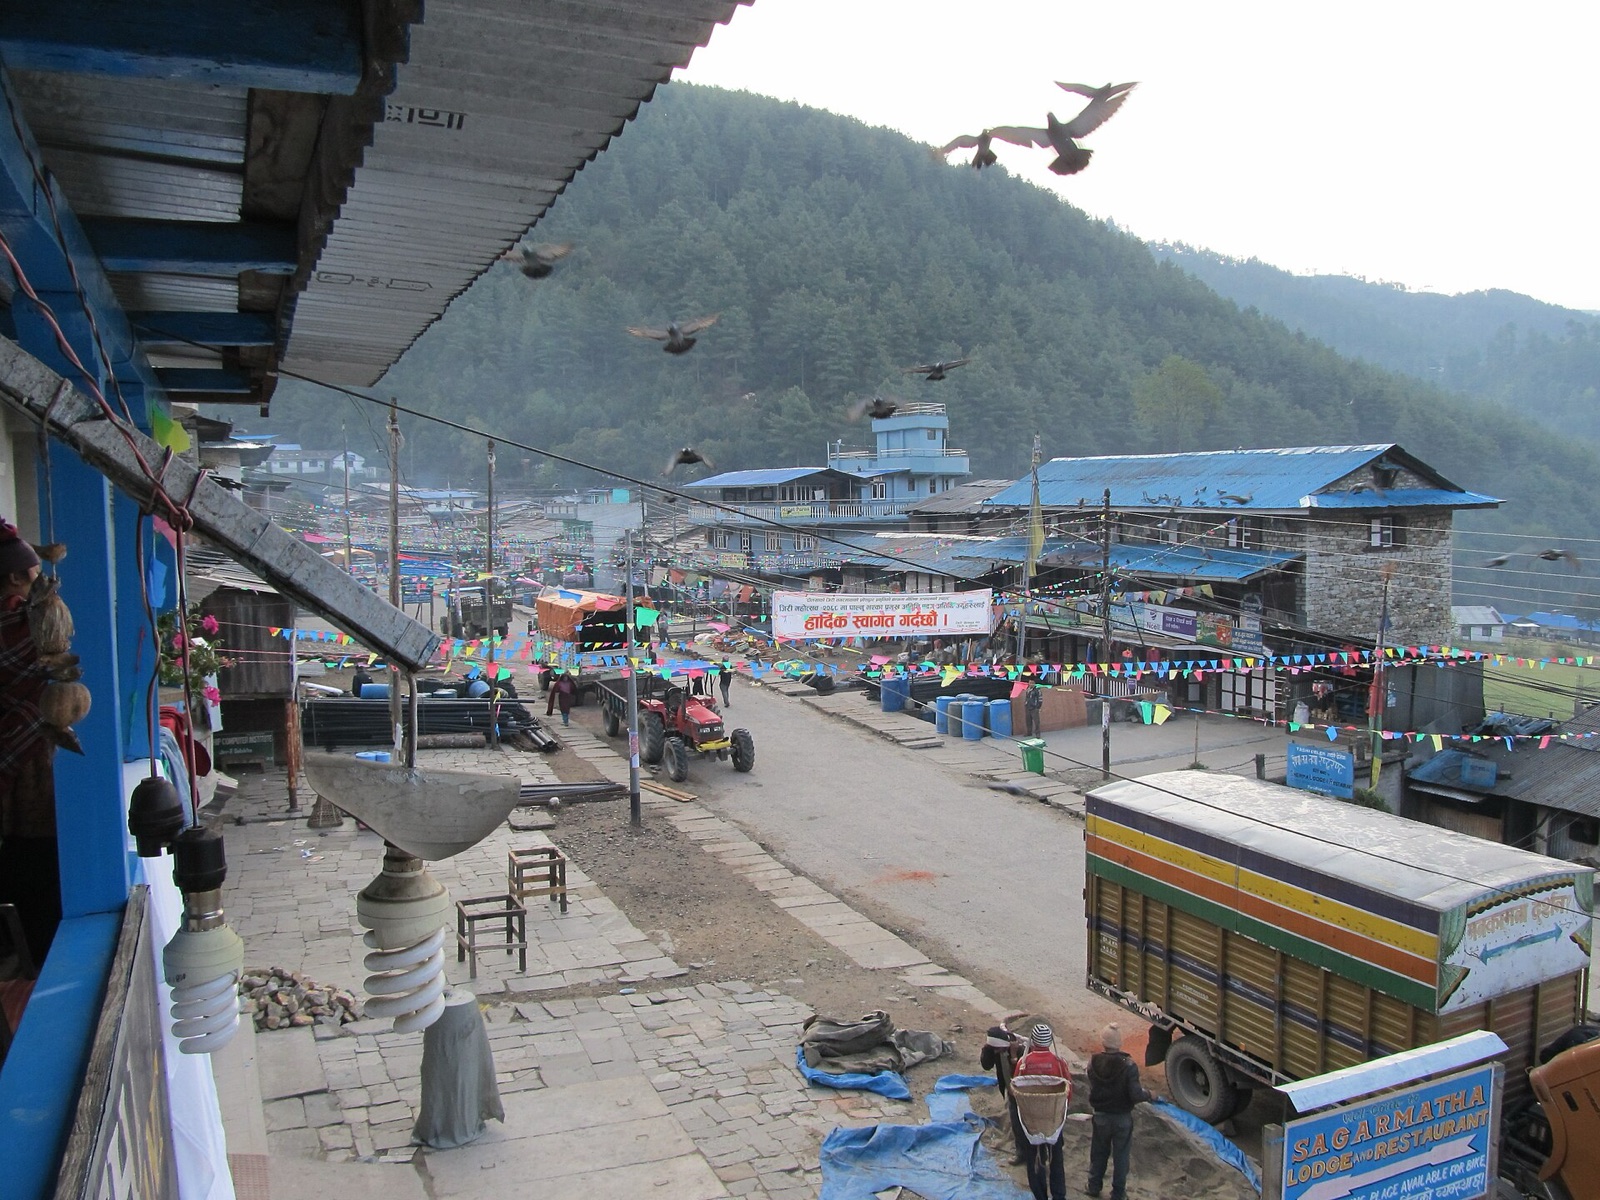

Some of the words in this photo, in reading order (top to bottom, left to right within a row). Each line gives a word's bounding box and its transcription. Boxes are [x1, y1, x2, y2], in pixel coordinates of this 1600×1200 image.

[779, 604, 793, 612] जिरी
[794, 603, 819, 612] महोत्सव
[804, 611, 847, 630] हार्दिक
[852, 612, 896, 629] स्वागत
[1293, 1085, 1486, 1163] SAGARMATHA
[1288, 1152, 1353, 1187] LODGE
[1354, 1149, 1374, 1165] AND
[1374, 1111, 1490, 1161] RESTAURANT
[1371, 1183, 1399, 1200] PLACE
[1401, 1169, 1447, 1191] AVAILABLE
[1449, 1165, 1466, 1179] FOR
